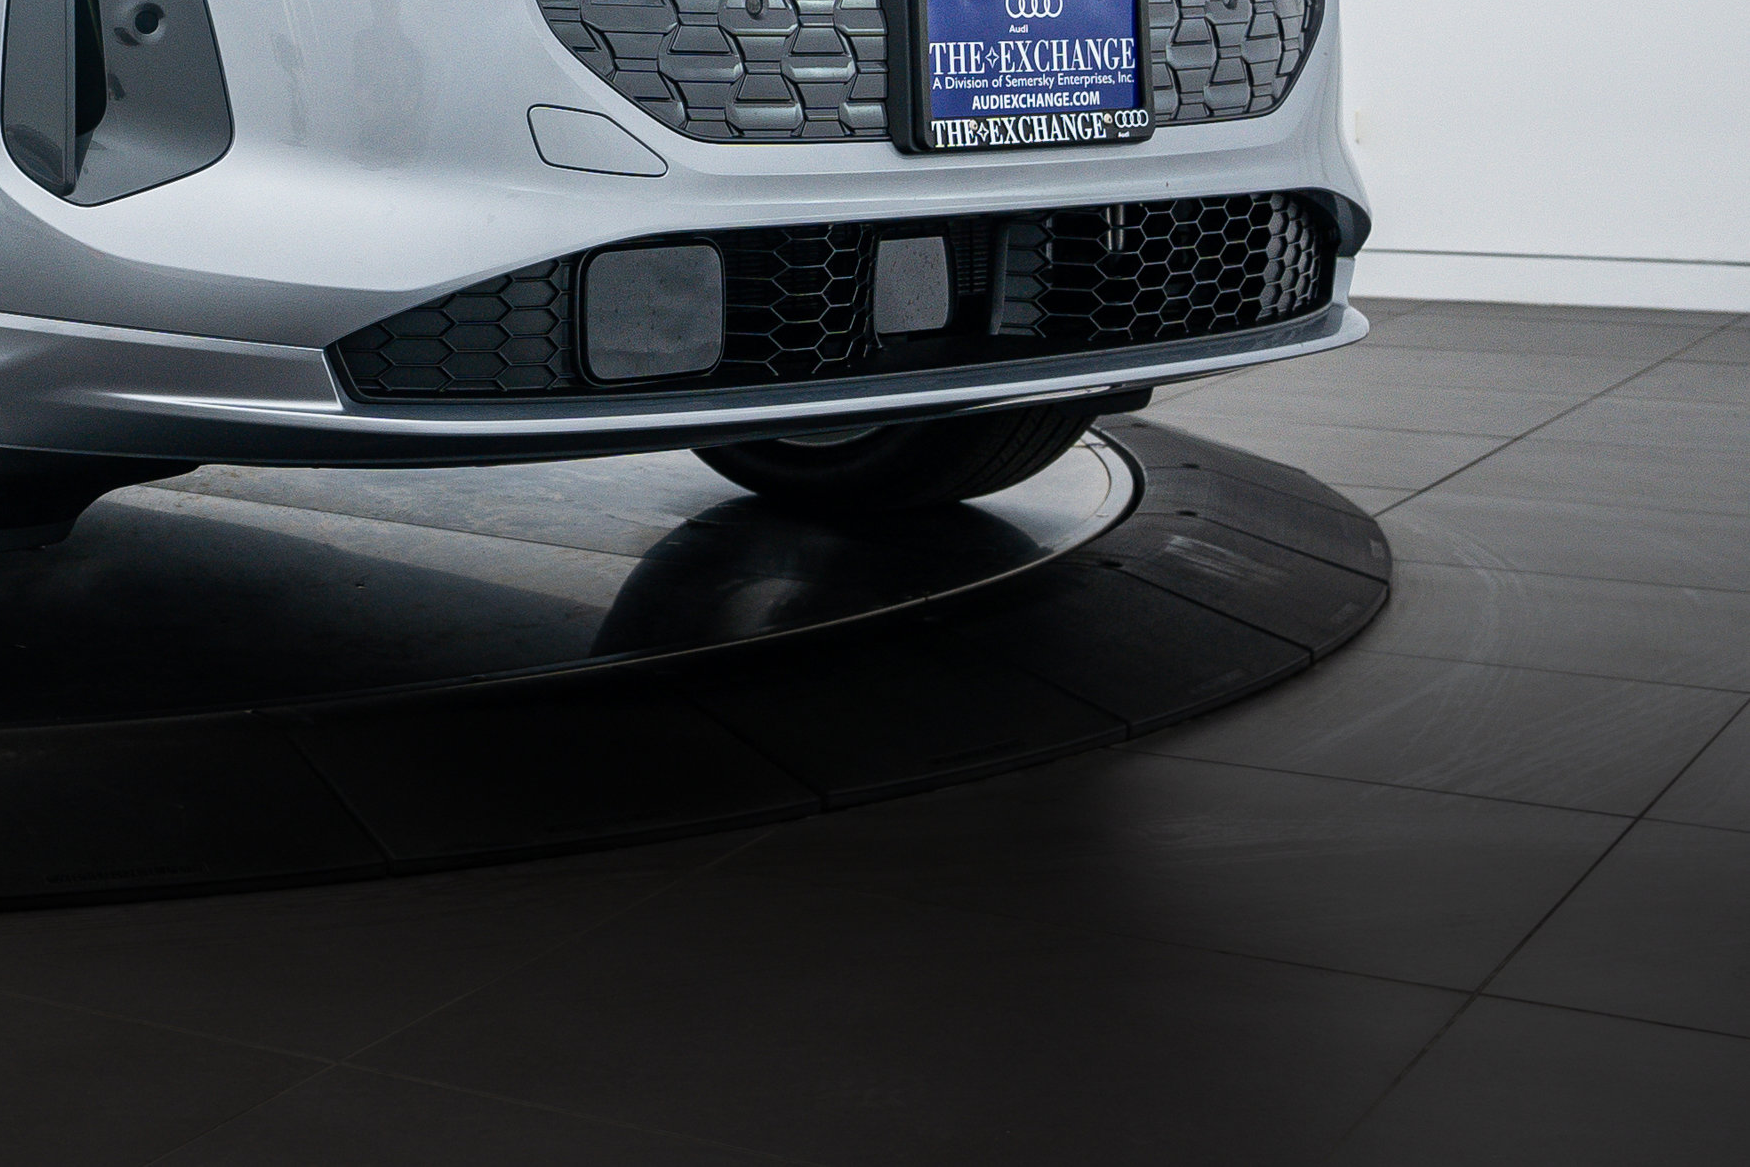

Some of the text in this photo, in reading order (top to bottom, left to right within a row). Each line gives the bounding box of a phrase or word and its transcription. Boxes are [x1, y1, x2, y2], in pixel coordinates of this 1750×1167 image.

[1009, 24, 1029, 33] Audi
[929, 37, 1136, 75] THE EXCHANGE
[932, 71, 1134, 90] A Division of Semersky Enterprises, Inc.
[972, 91, 1100, 110] AUDIEXCHANGE.COM
[931, 112, 1107, 148] THE EXCHANGE
